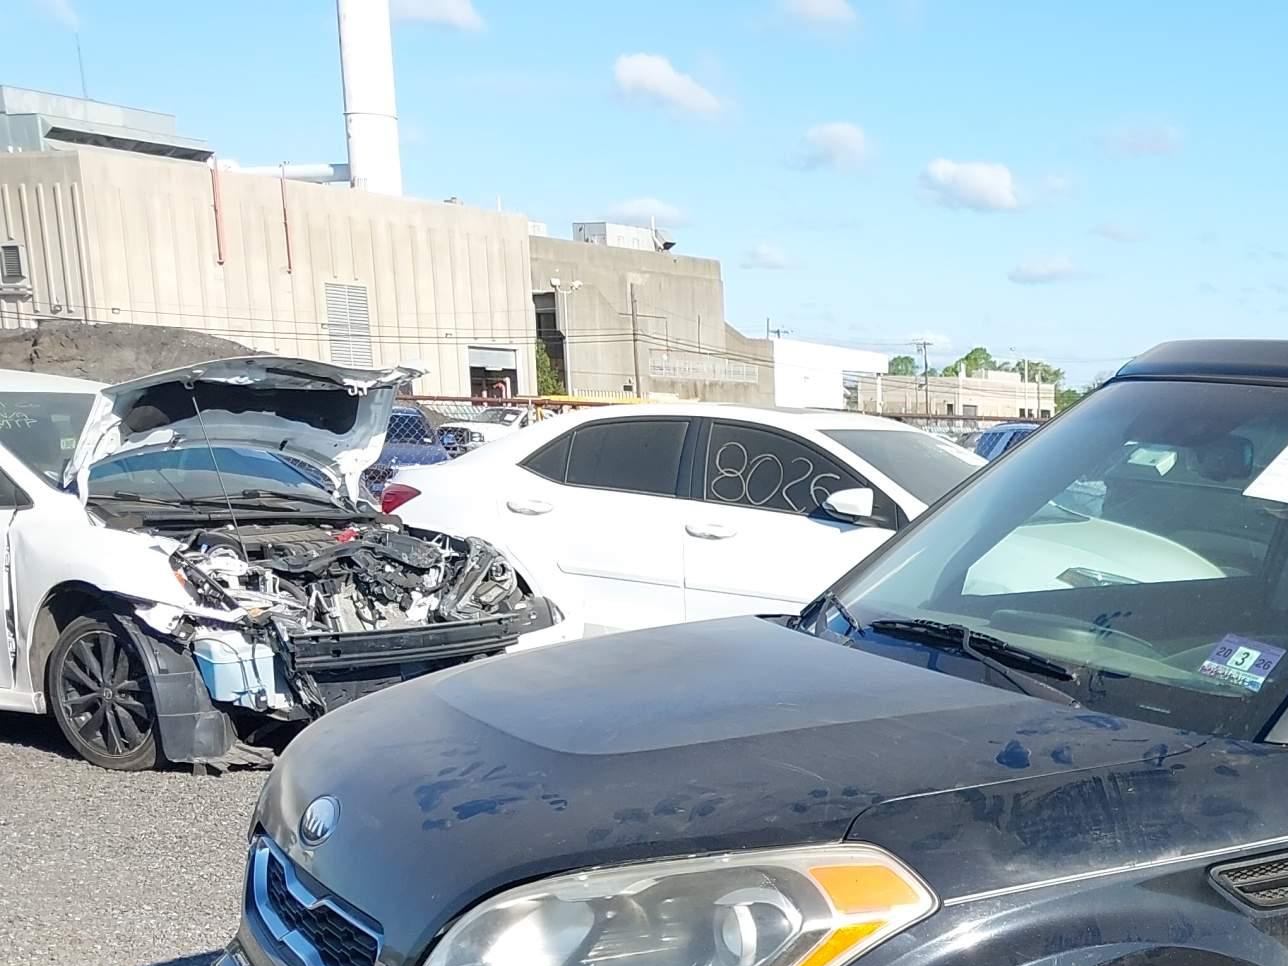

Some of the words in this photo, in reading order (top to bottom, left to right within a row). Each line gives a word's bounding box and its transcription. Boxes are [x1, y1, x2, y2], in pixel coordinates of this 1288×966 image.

[1216, 647, 1233, 658] 20
[1235, 651, 1250, 666] 3
[1255, 659, 1273, 671] 26
